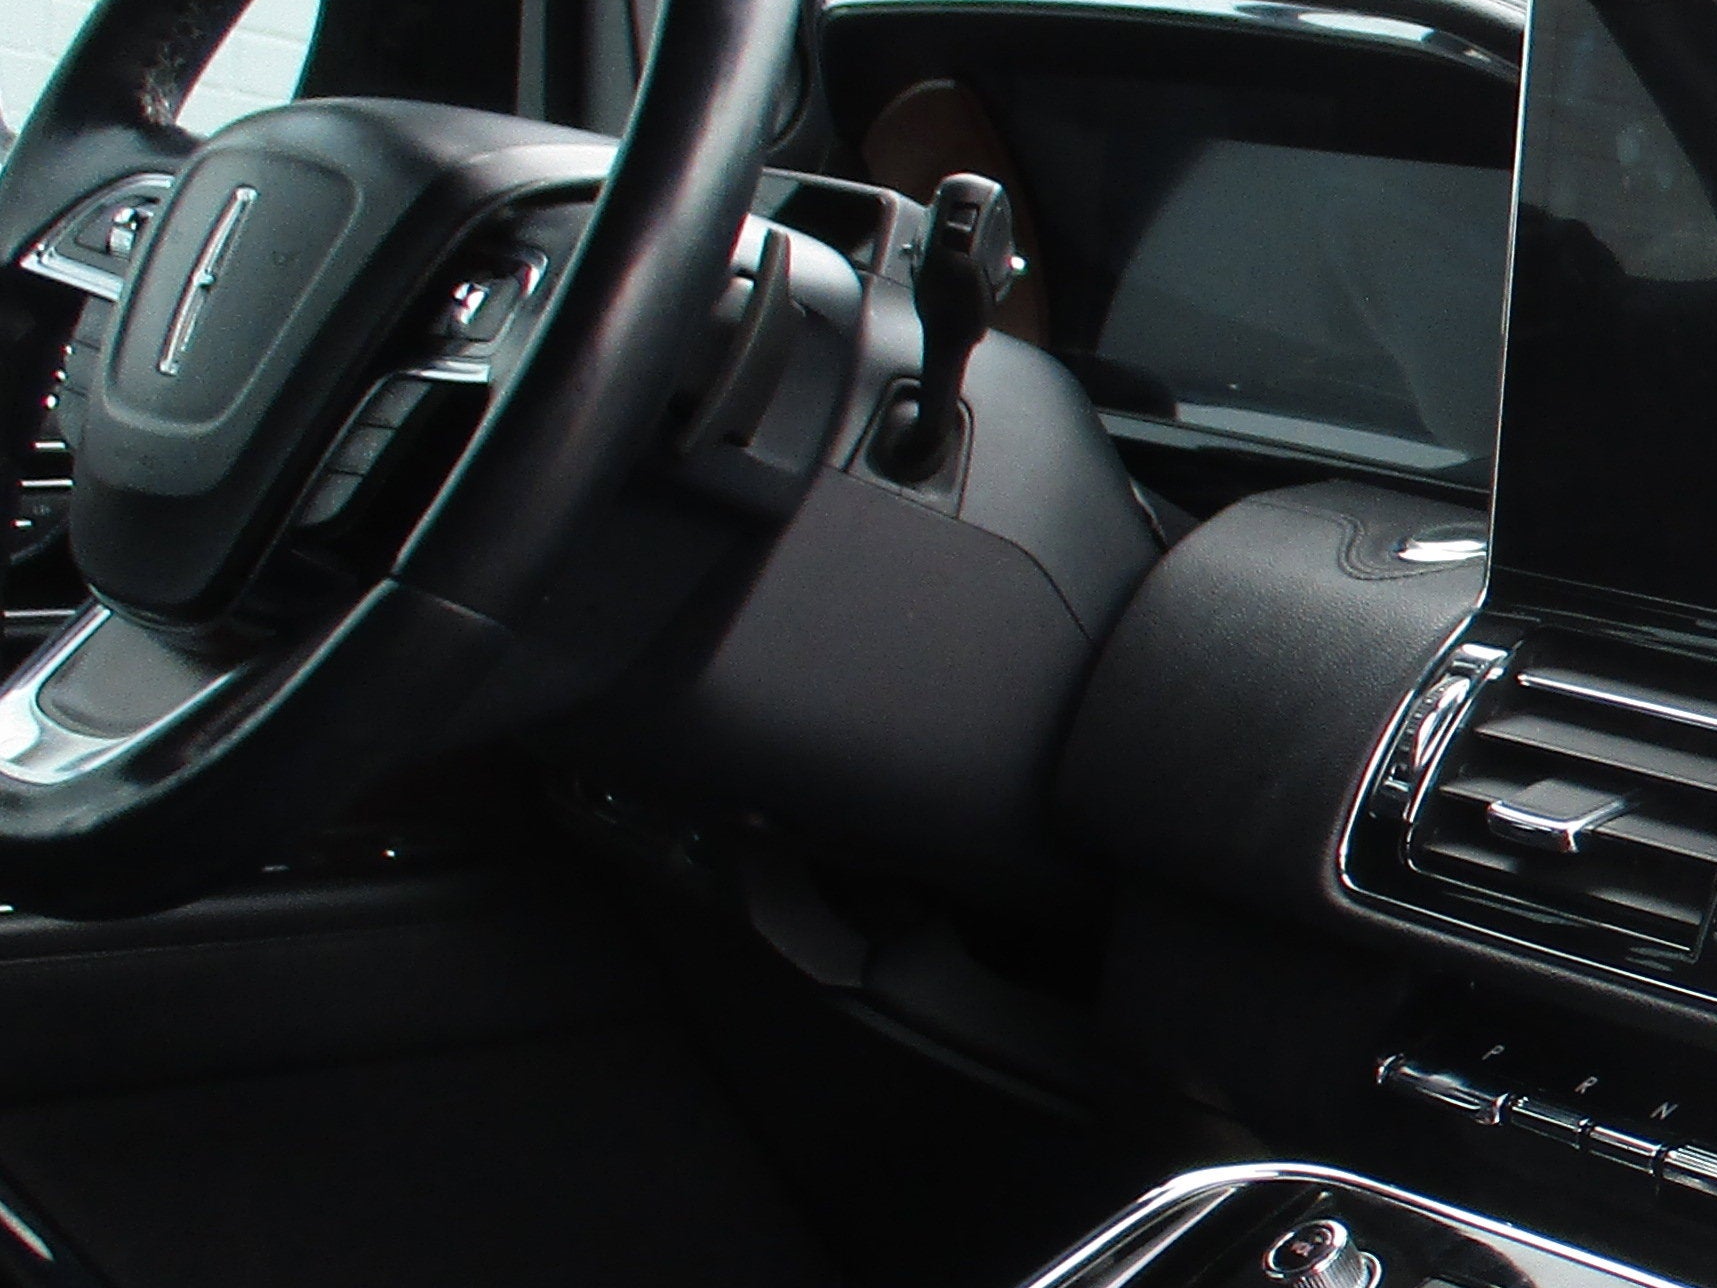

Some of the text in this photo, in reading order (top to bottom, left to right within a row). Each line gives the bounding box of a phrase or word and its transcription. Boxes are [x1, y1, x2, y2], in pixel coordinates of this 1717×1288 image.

[1481, 1043, 1505, 1061] P
[1573, 1075, 1599, 1095] R
[1650, 1101, 1679, 1121] N
